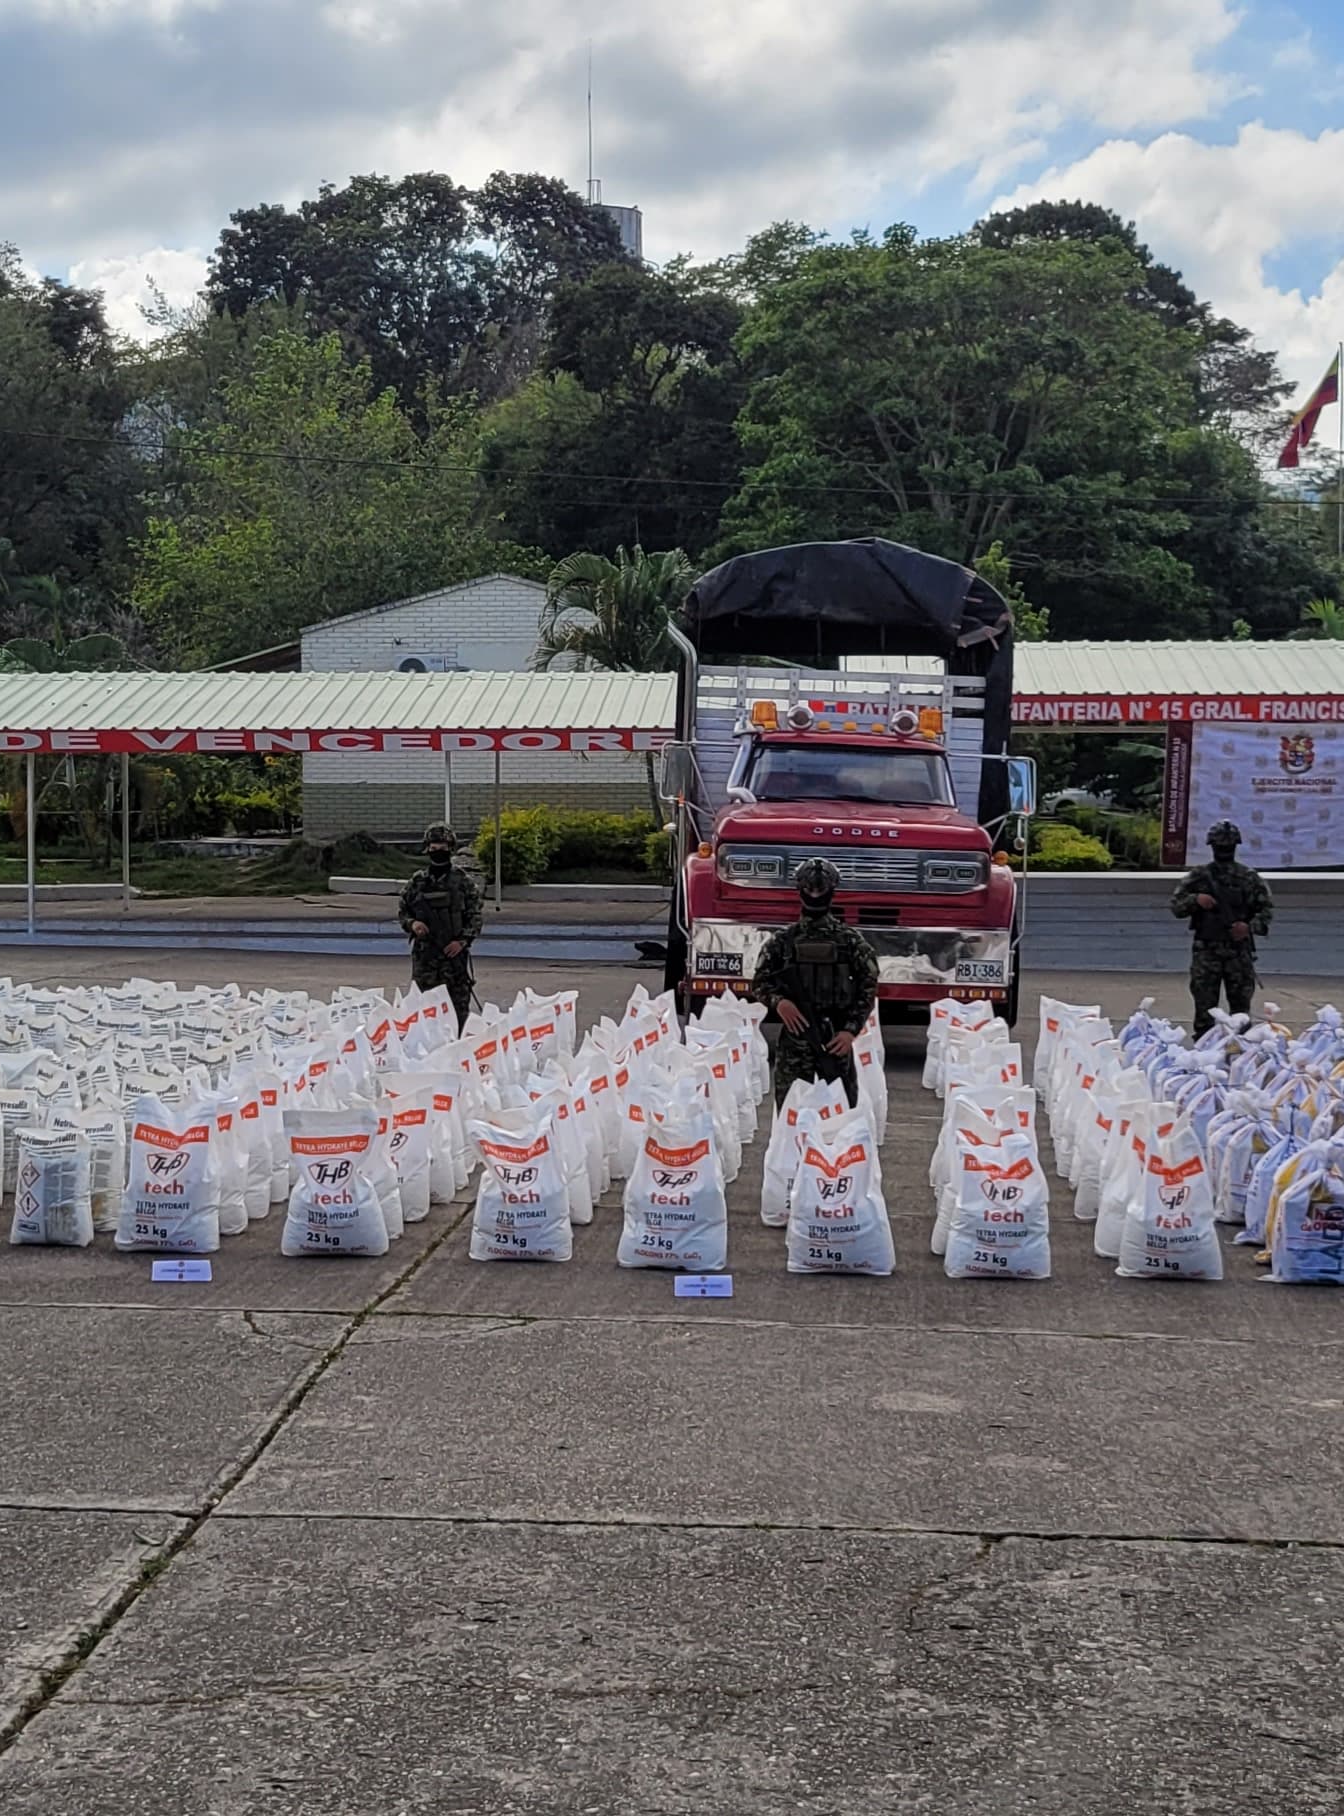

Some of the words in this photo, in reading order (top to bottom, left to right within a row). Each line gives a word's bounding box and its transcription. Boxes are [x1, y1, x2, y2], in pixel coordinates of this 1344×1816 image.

[1010, 701, 1123, 721] NFANTERIA
[1158, 701, 1183, 720] 15
[1189, 701, 1253, 721] GRAL.
[130, 731, 675, 752] VENCEDORE
[812, 826, 899, 838] DODGE
[316, 1161, 351, 1184] THB
[502, 1168, 533, 1185] THB
[657, 1171, 693, 1189] THB
[144, 1180, 184, 1195] tech
[314, 1189, 353, 1205] tech
[501, 1190, 541, 1205] tech
[649, 1192, 691, 1206] tech
[814, 1204, 854, 1219] tech
[983, 1209, 1024, 1224] tech
[1155, 1212, 1192, 1230] tech
[135, 1223, 149, 1234] 25
[152, 1225, 168, 1239] kg
[306, 1232, 321, 1243] 25
[324, 1232, 340, 1246] kg
[494, 1233, 509, 1244] 25
[512, 1234, 527, 1248] kg
[641, 1235, 656, 1246] 25
[657, 1237, 673, 1250] kg
[808, 1248, 823, 1258] 25
[826, 1248, 842, 1262] kg
[973, 1251, 989, 1263] 25
[992, 1252, 1008, 1267] kg
[1144, 1256, 1160, 1267] 25
[1164, 1258, 1180, 1271] kg
